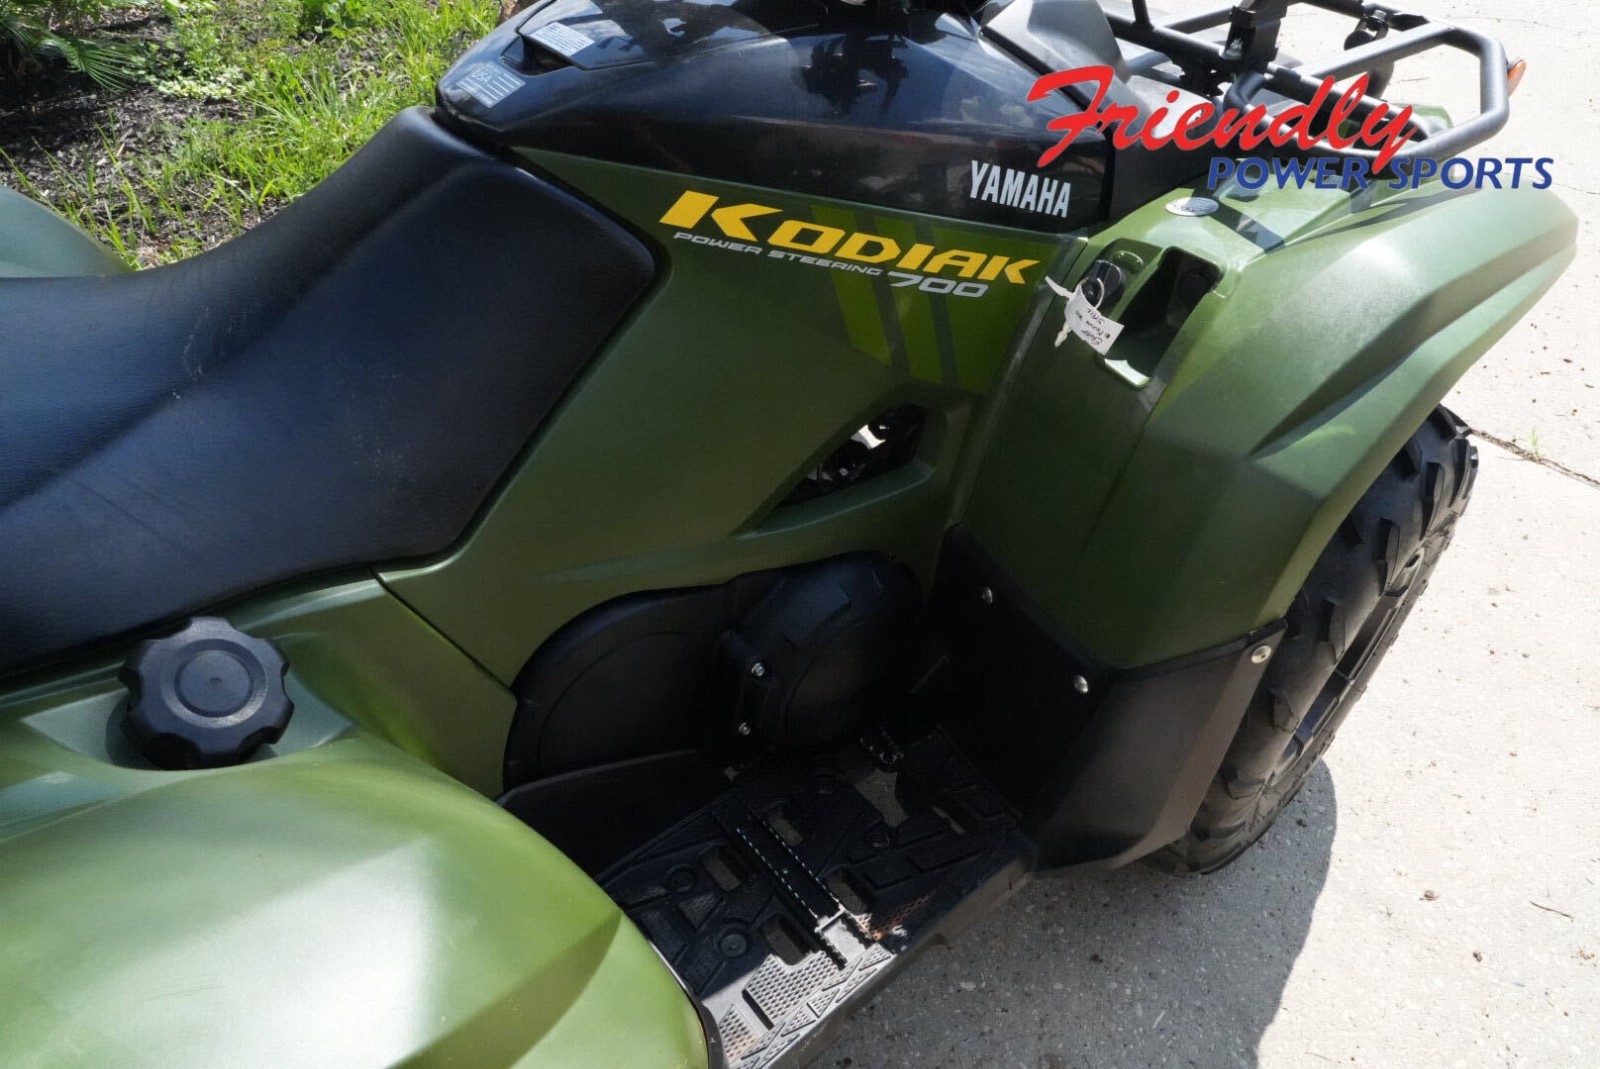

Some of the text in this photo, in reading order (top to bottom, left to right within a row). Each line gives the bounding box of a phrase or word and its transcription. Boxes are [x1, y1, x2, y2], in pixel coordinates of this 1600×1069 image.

[970, 160, 1071, 218] YAMAHA
[659, 190, 1041, 285] KODIAK
[673, 231, 989, 298] POWER STEERING 700
